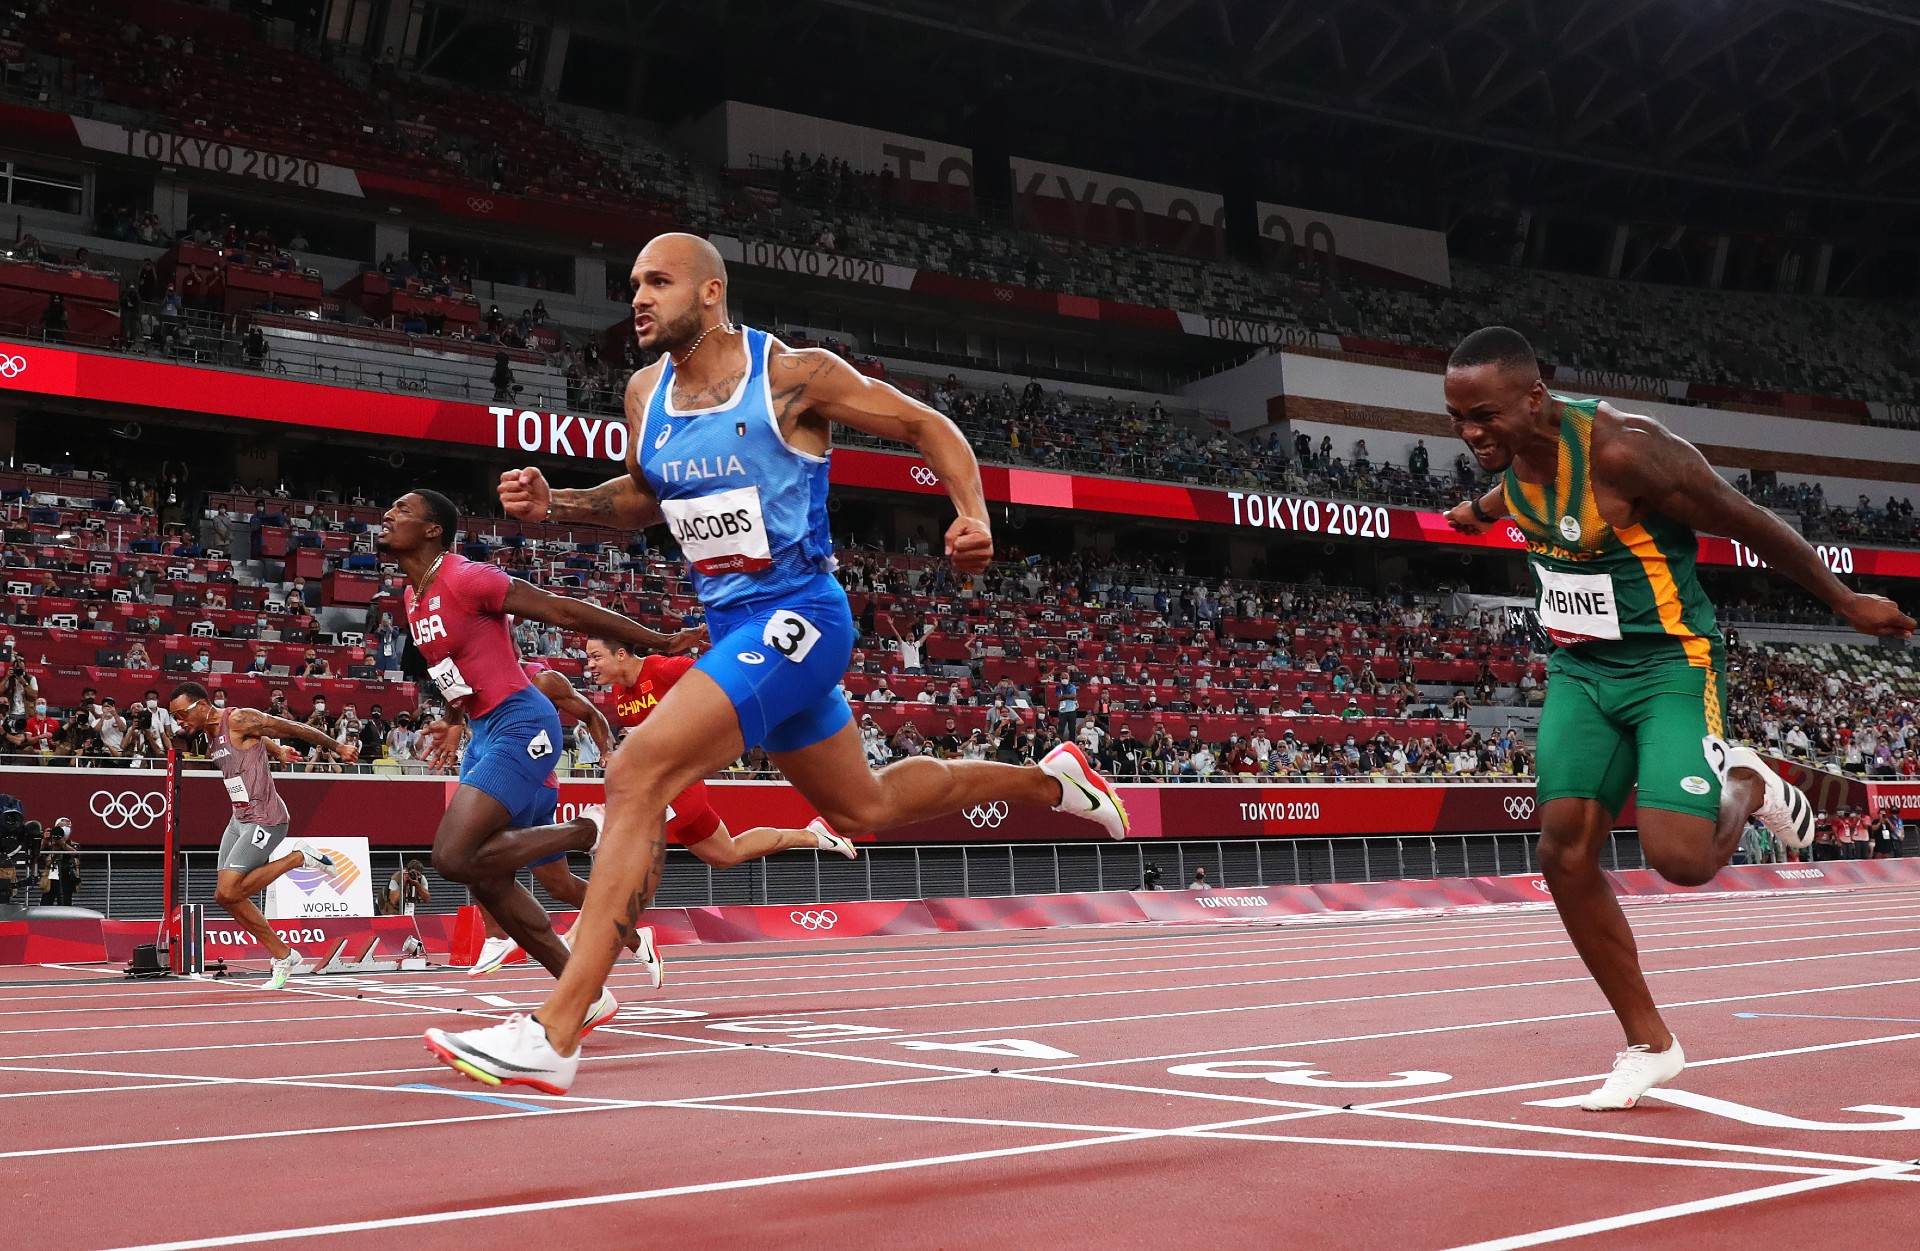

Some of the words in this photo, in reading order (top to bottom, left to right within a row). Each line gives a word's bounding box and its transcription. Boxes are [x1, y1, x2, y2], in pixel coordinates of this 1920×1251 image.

[122, 126, 233, 173] TOKYO
[242, 148, 320, 190] 2020
[739, 239, 820, 275] TOKYO
[827, 255, 885, 286] 2020
[1205, 315, 1270, 345] TOKYO
[1273, 326, 1319, 351] 2020
[487, 406, 628, 462] TOKYO
[661, 454, 746, 483] ITALIA
[674, 508, 752, 541] JACOBS
[1227, 492, 1320, 532] TOKYO
[1325, 502, 1390, 539] 2020
[1816, 545, 1854, 574] 020
[1545, 589, 1608, 615] MBINE
[409, 613, 448, 647] USA
[772, 617, 806, 657] 3
[434, 668, 456, 692] LEY
[616, 692, 659, 717] CHINA
[1239, 802, 1285, 820] TOKYO
[1287, 802, 1320, 820] 2020
[1872, 794, 1901, 809] TOKYO
[254, 829, 265, 844] 9
[303, 902, 349, 912] WORLD
[1194, 896, 1239, 909] TOKYO
[1239, 894, 1269, 907] 2020
[205, 930, 258, 945] TOKY
[277, 928, 326, 943] 2020
[889, 1037, 1080, 1060] 4
[1165, 1059, 1454, 1089] 3
